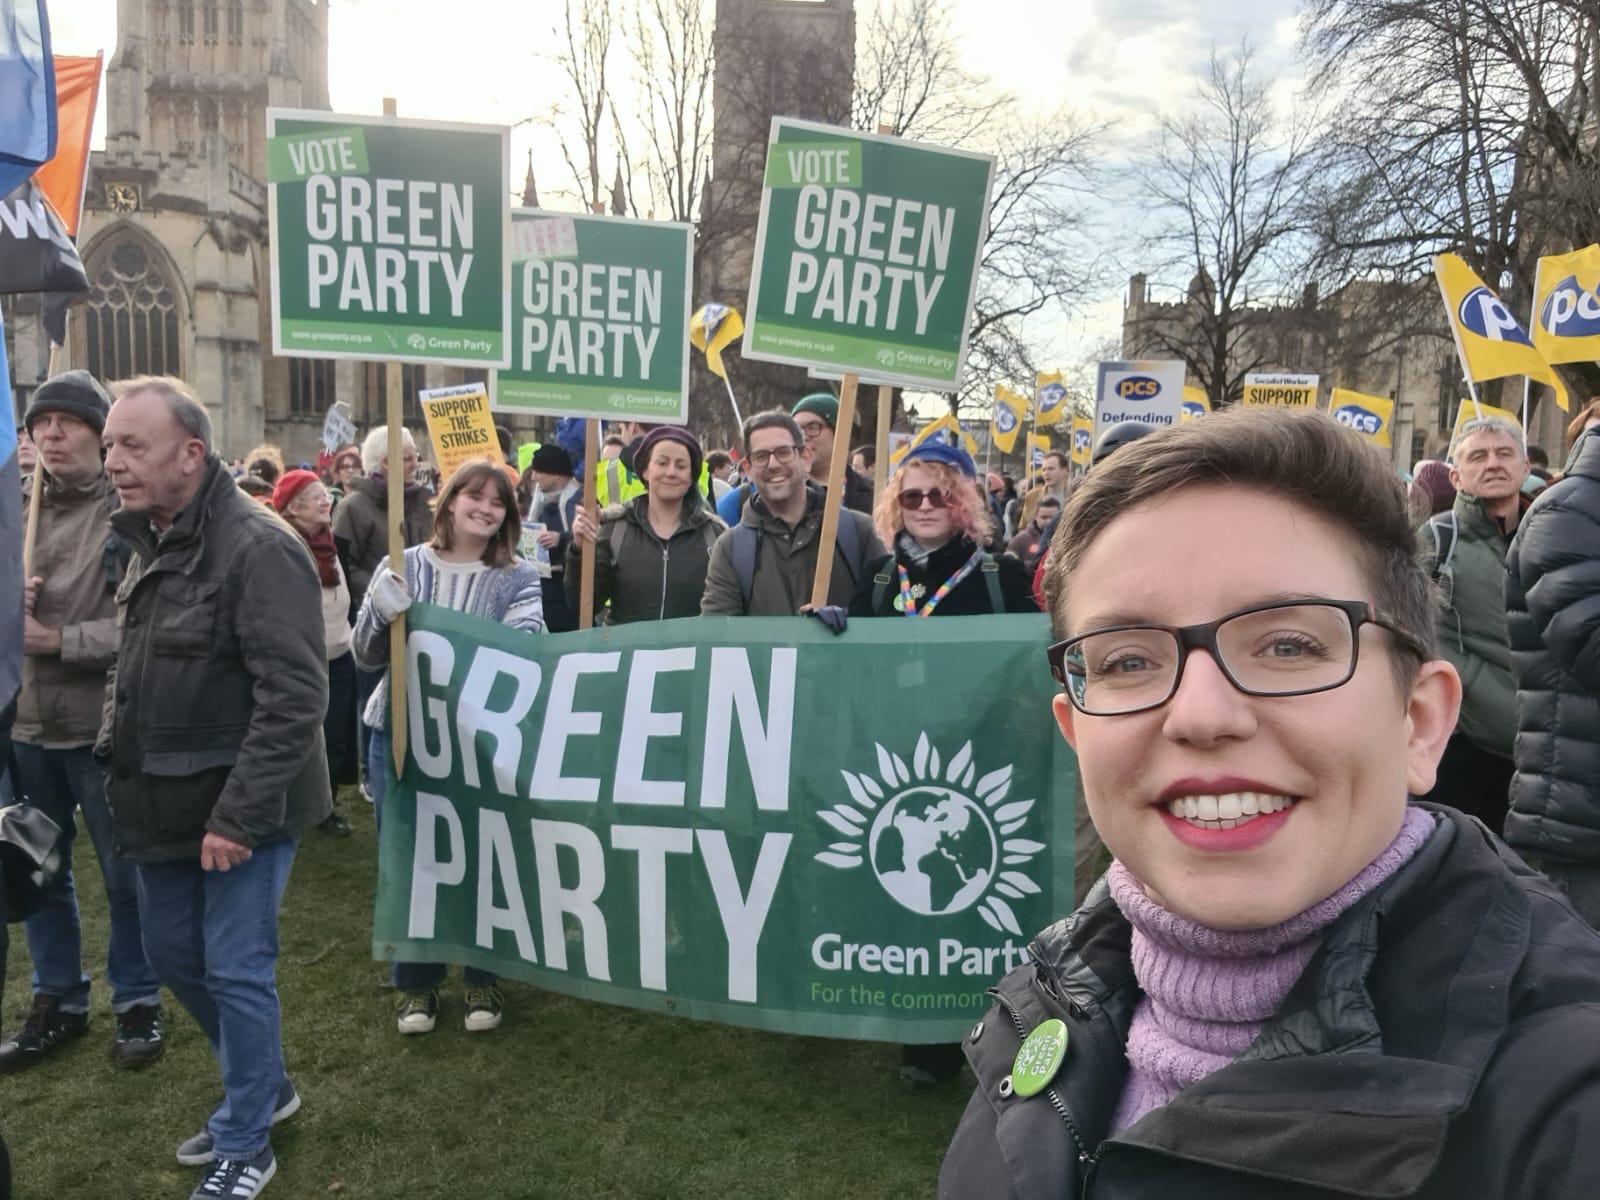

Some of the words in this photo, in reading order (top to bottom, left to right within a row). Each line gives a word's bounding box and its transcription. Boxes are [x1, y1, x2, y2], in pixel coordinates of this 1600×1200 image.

[288, 136, 356, 175] VOTE
[787, 149, 850, 184] VOTE
[305, 174, 474, 250] GREEN
[794, 184, 955, 271] GREEN
[307, 244, 475, 317] PARTY
[522, 260, 662, 325] GREEN
[784, 251, 945, 336] PARTY
[428, 337, 461, 349] Green
[463, 339, 492, 354] Party
[522, 317, 660, 380] PARTY
[896, 351, 927, 364] Green
[928, 356, 954, 370] Party
[626, 393, 653, 405] Green
[654, 396, 678, 408] Party
[1120, 380, 1157, 399] pcs
[1250, 389, 1311, 405] SUPPORT
[430, 397, 483, 418] SUPPORT
[449, 415, 472, 431] THE
[1102, 412, 1173, 425] Defending
[440, 429, 489, 449] STRIKES
[407, 629, 797, 811] GREEN
[407, 791, 793, 1003] PARTY
[811, 933, 929, 976] Green
[811, 982, 843, 1003] For
[849, 984, 885, 1005] the
[892, 991, 983, 1009] common
